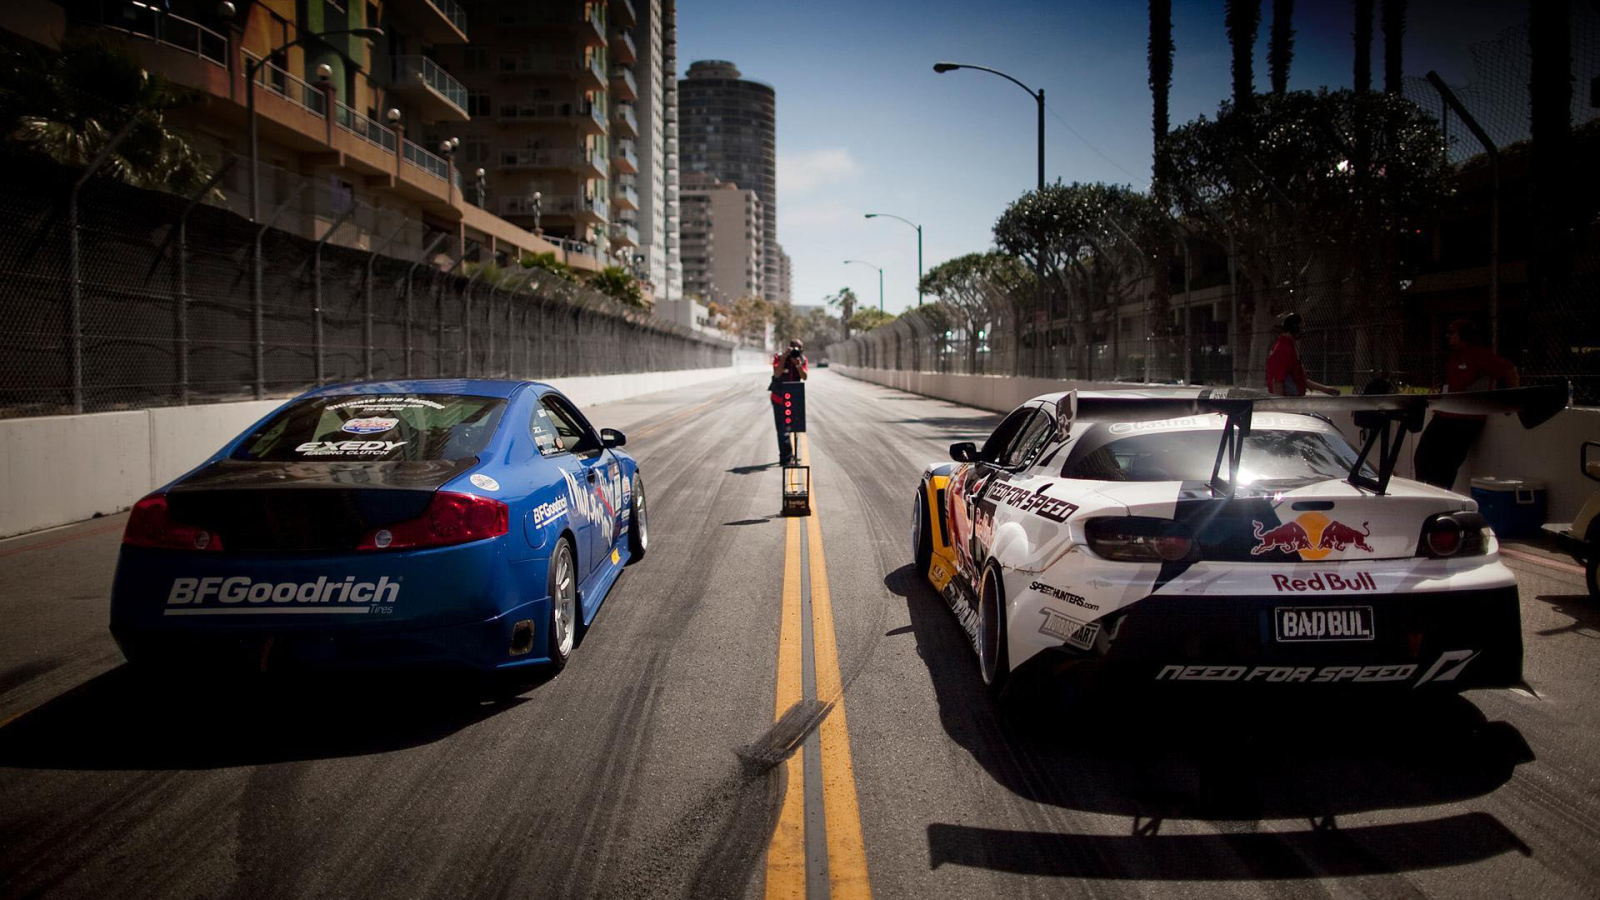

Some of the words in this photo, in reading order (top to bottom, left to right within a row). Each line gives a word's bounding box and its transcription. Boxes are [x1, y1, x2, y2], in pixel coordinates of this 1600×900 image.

[1131, 416, 1199, 431] Castrol
[295, 440, 409, 452] EXEDY
[533, 493, 569, 525] BFGoodrich
[1006, 486, 1031, 508] FOR
[1019, 494, 1080, 523] SPEED
[166, 575, 401, 605] BFGoodrich
[1271, 573, 1326, 592] Red
[1324, 572, 1377, 591] Bull
[370, 603, 394, 615] Tires
[1155, 664, 1247, 681] NEED
[1244, 666, 1316, 682] FOR
[1311, 664, 1418, 682] SPEED
